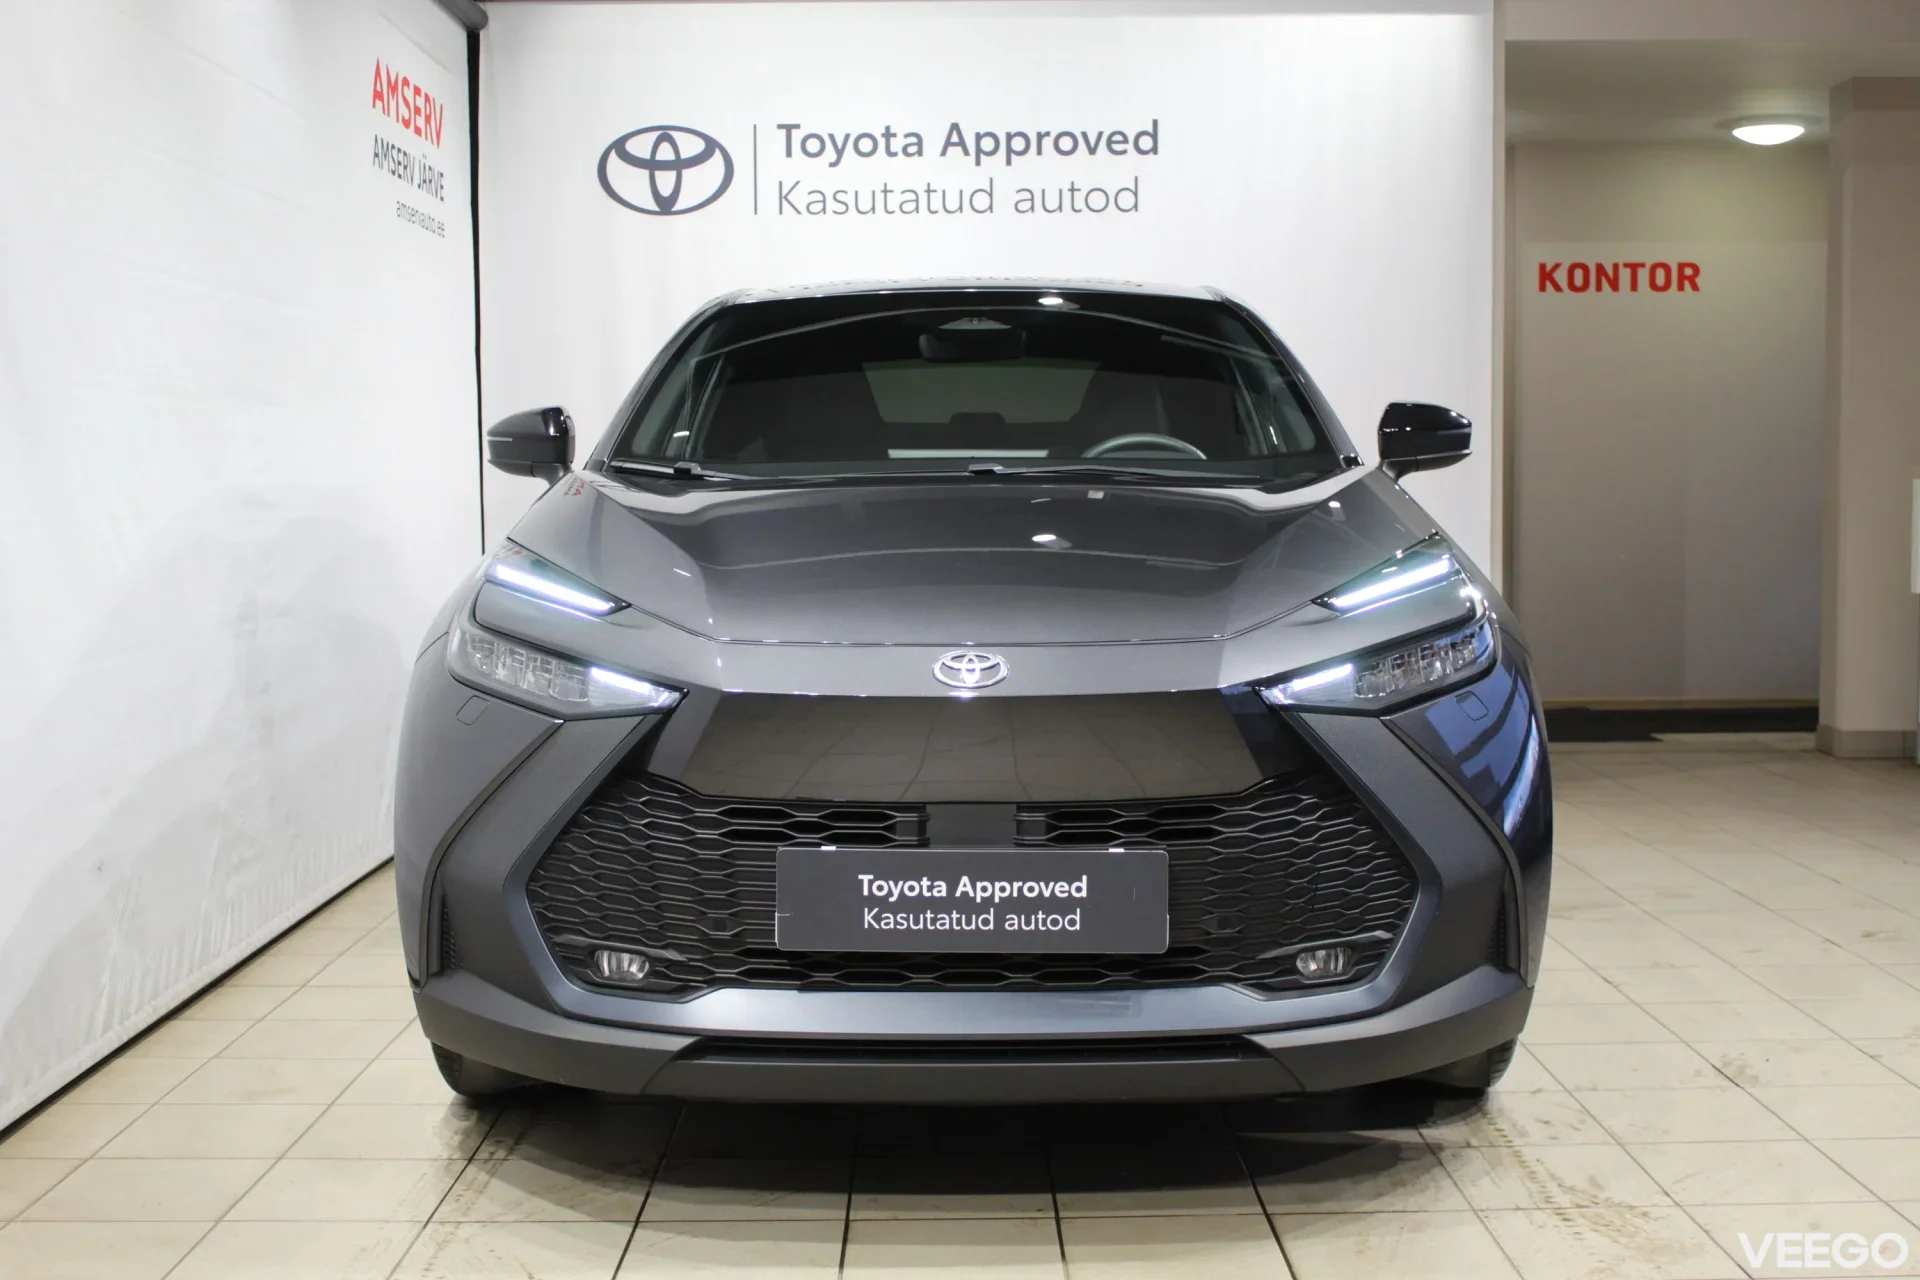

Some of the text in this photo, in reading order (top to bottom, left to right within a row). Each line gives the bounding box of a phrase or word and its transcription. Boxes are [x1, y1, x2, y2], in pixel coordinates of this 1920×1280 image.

[372, 56, 444, 149] AMSERV
[777, 119, 1159, 167] Toyota Approved
[372, 134, 444, 202] AMSERV JÄRVE
[778, 176, 1139, 215] Kasutatud autod
[396, 200, 445, 238] amservauto.ee
[1538, 262, 1701, 293] KONTOR
[858, 874, 1088, 903] Toyota Approved
[864, 907, 1081, 931] Kasutatud autod
